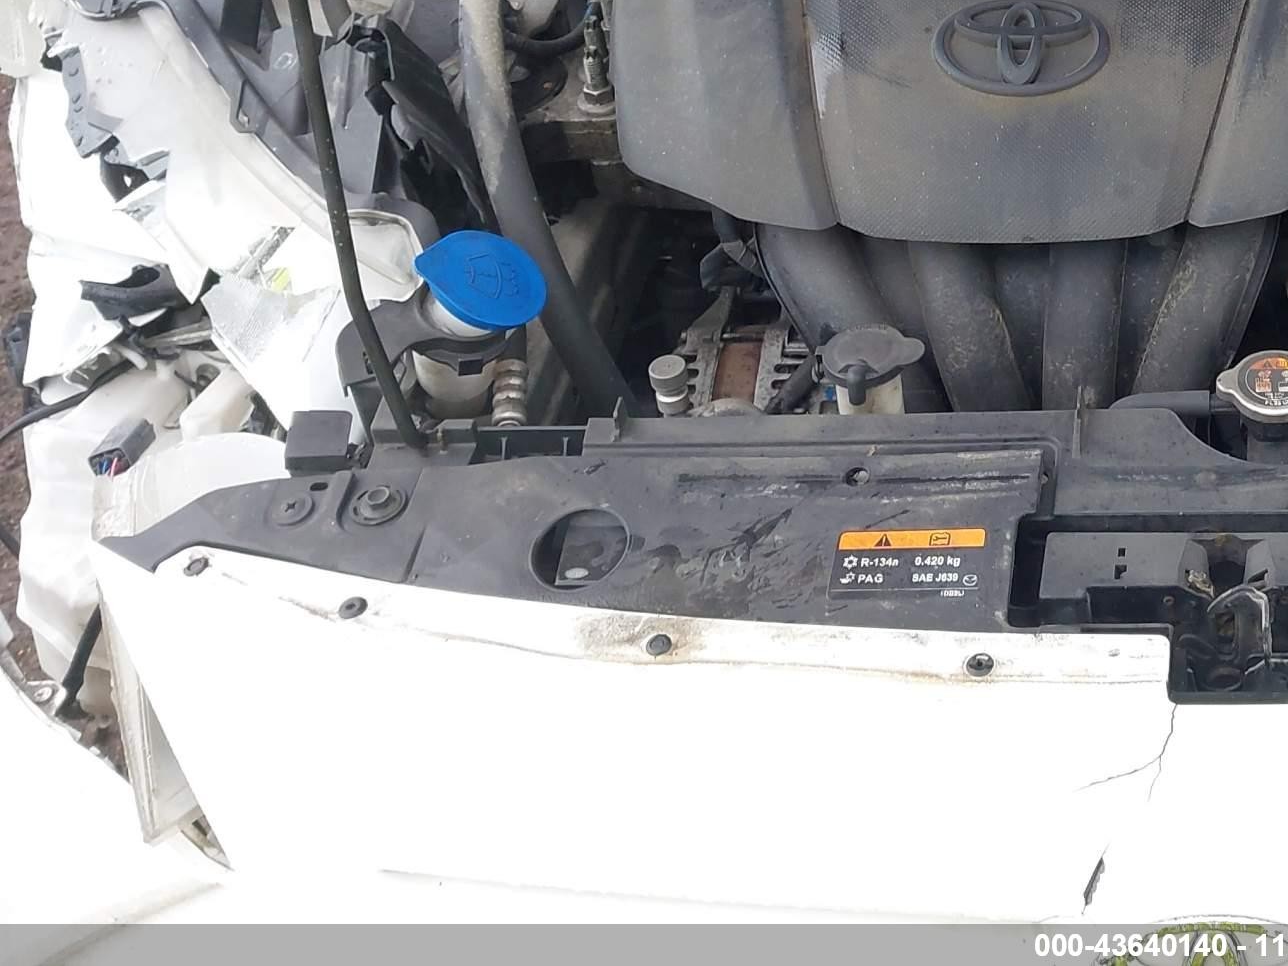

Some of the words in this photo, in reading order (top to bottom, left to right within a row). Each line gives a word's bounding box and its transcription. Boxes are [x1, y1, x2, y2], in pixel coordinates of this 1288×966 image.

[914, 556, 944, 566] 0.420
[946, 556, 961, 567] kg
[857, 574, 884, 583] PAG
[912, 574, 934, 583] SAE
[935, 573, 959, 582] J639
